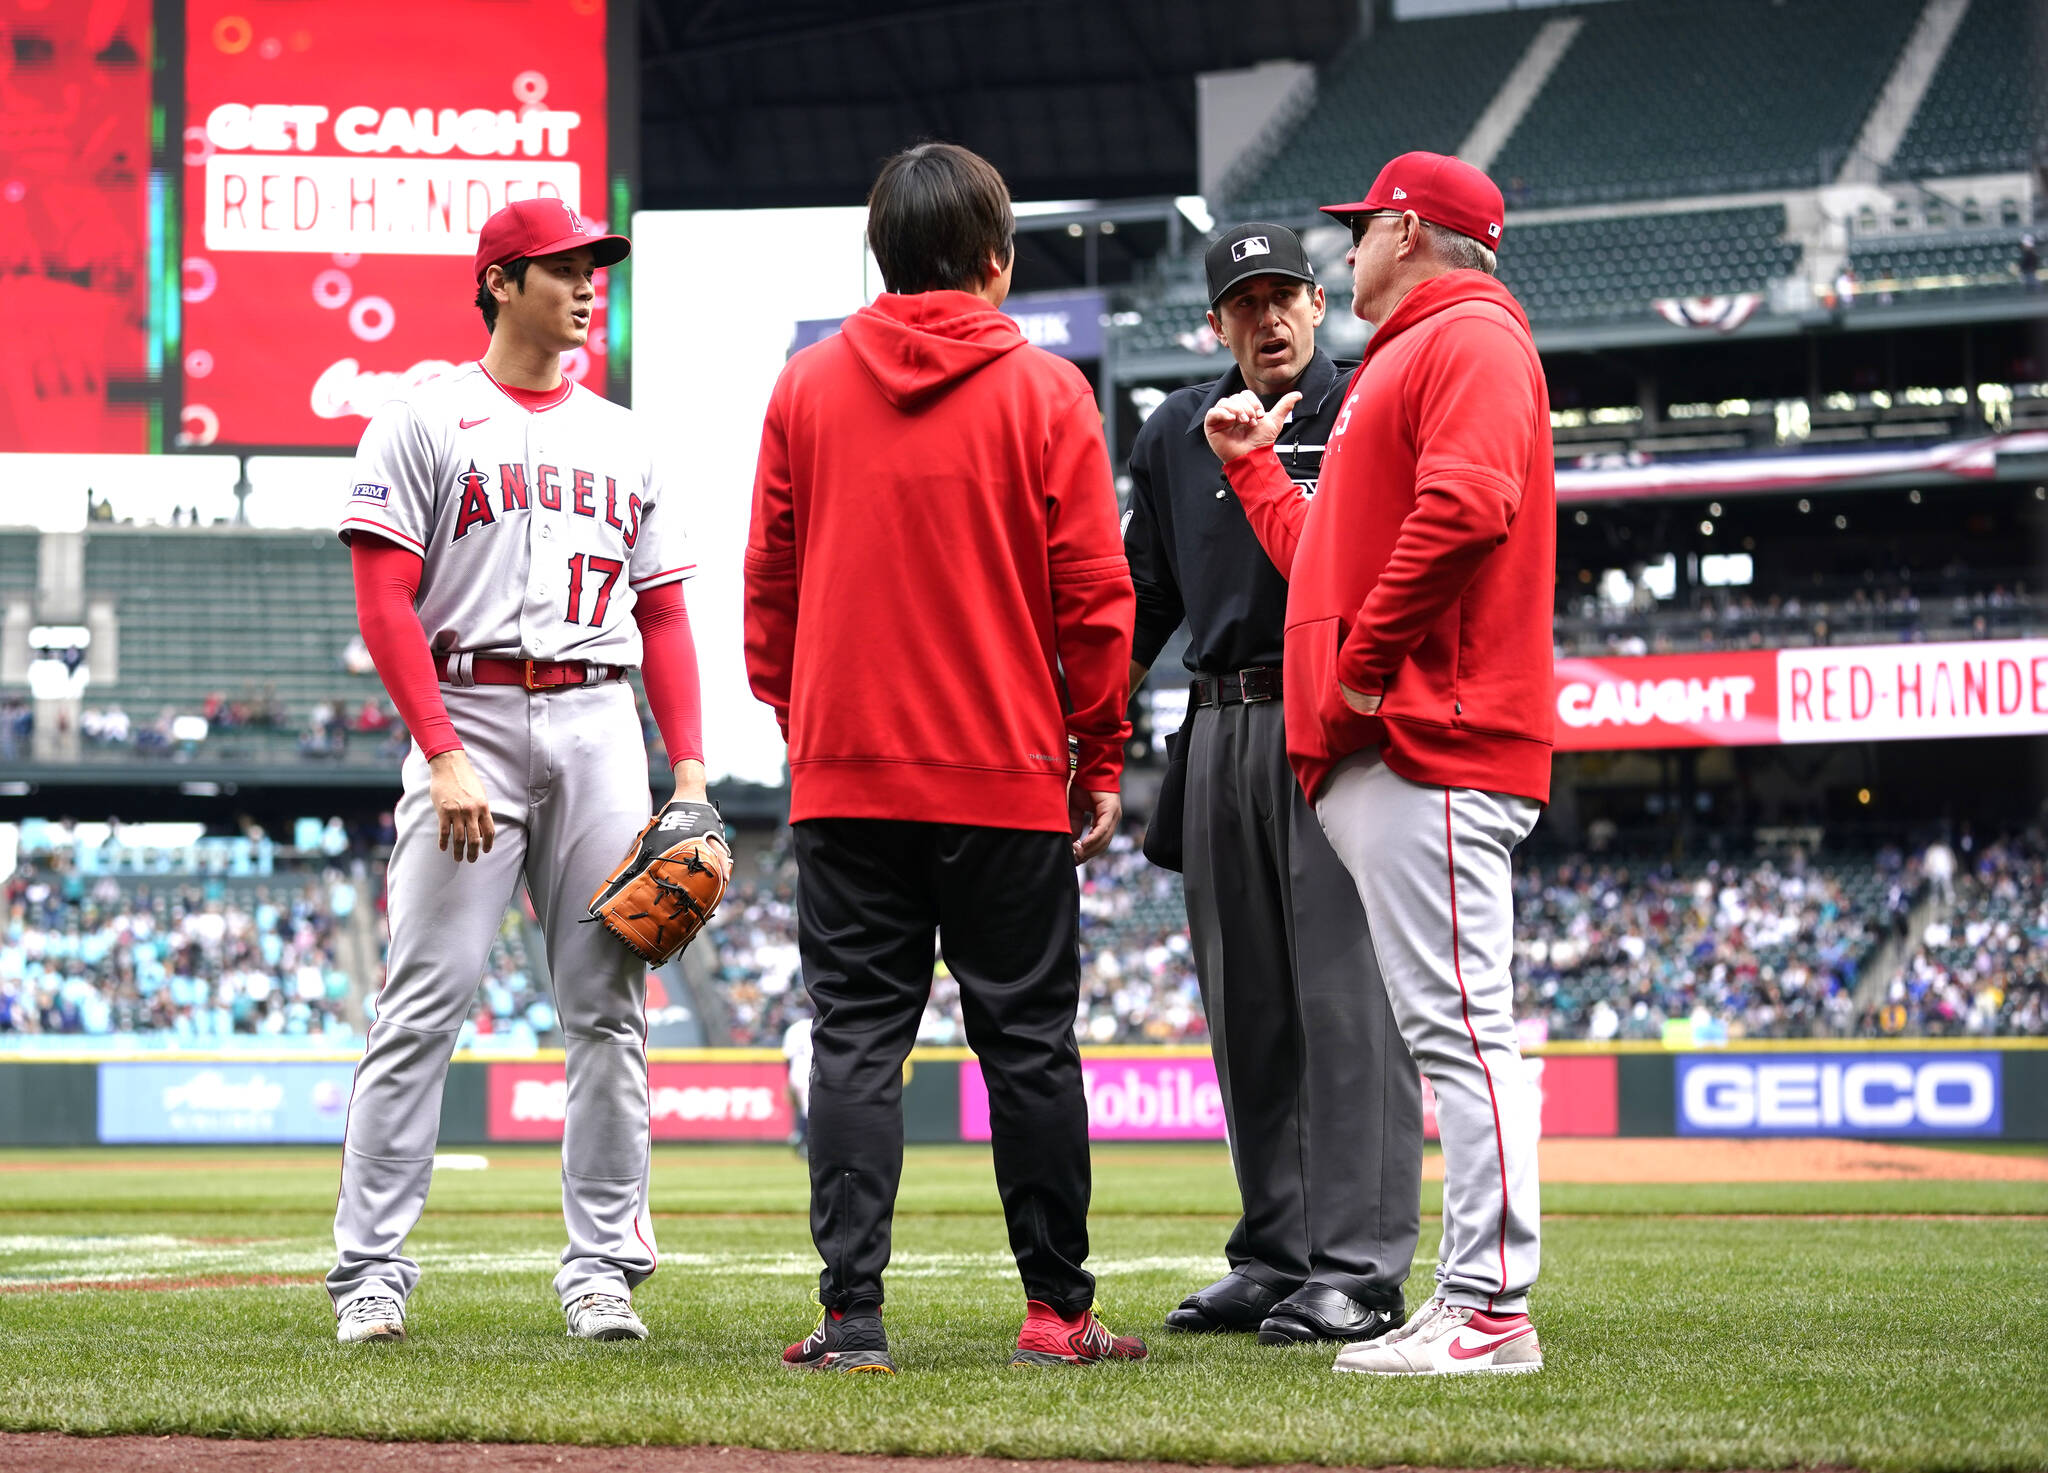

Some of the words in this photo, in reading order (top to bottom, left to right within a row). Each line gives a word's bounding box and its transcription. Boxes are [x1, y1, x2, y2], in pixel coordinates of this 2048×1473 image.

[206, 103, 329, 151] GET
[334, 106, 580, 157] CAUGHT
[353, 485, 386, 498] FBM
[451, 458, 642, 550] ANGELS
[563, 552, 624, 628] 17
[1557, 676, 1754, 728] CAUGHT
[1082, 1067, 1226, 1128] obile
[1683, 1062, 1995, 1128] GEICO
